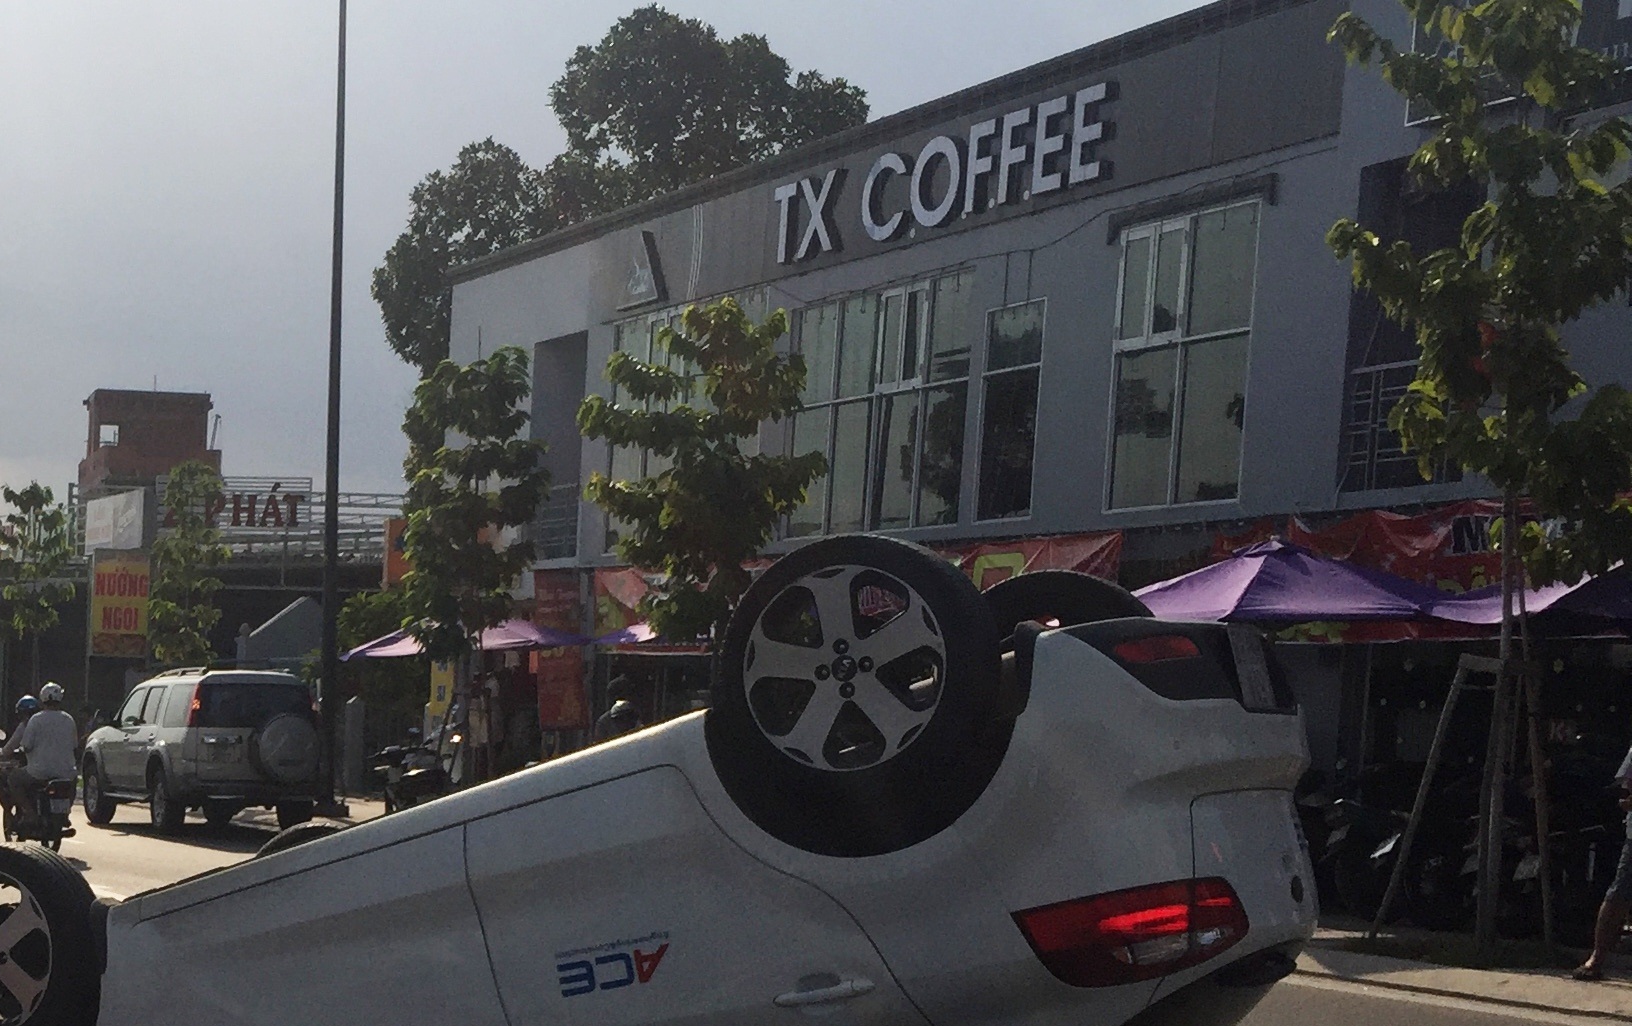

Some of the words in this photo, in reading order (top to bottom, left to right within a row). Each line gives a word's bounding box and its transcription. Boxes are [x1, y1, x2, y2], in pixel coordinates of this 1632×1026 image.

[774, 169, 838, 264] TX
[861, 82, 1107, 242] COFFEE
[556, 943, 669, 998] ACE
